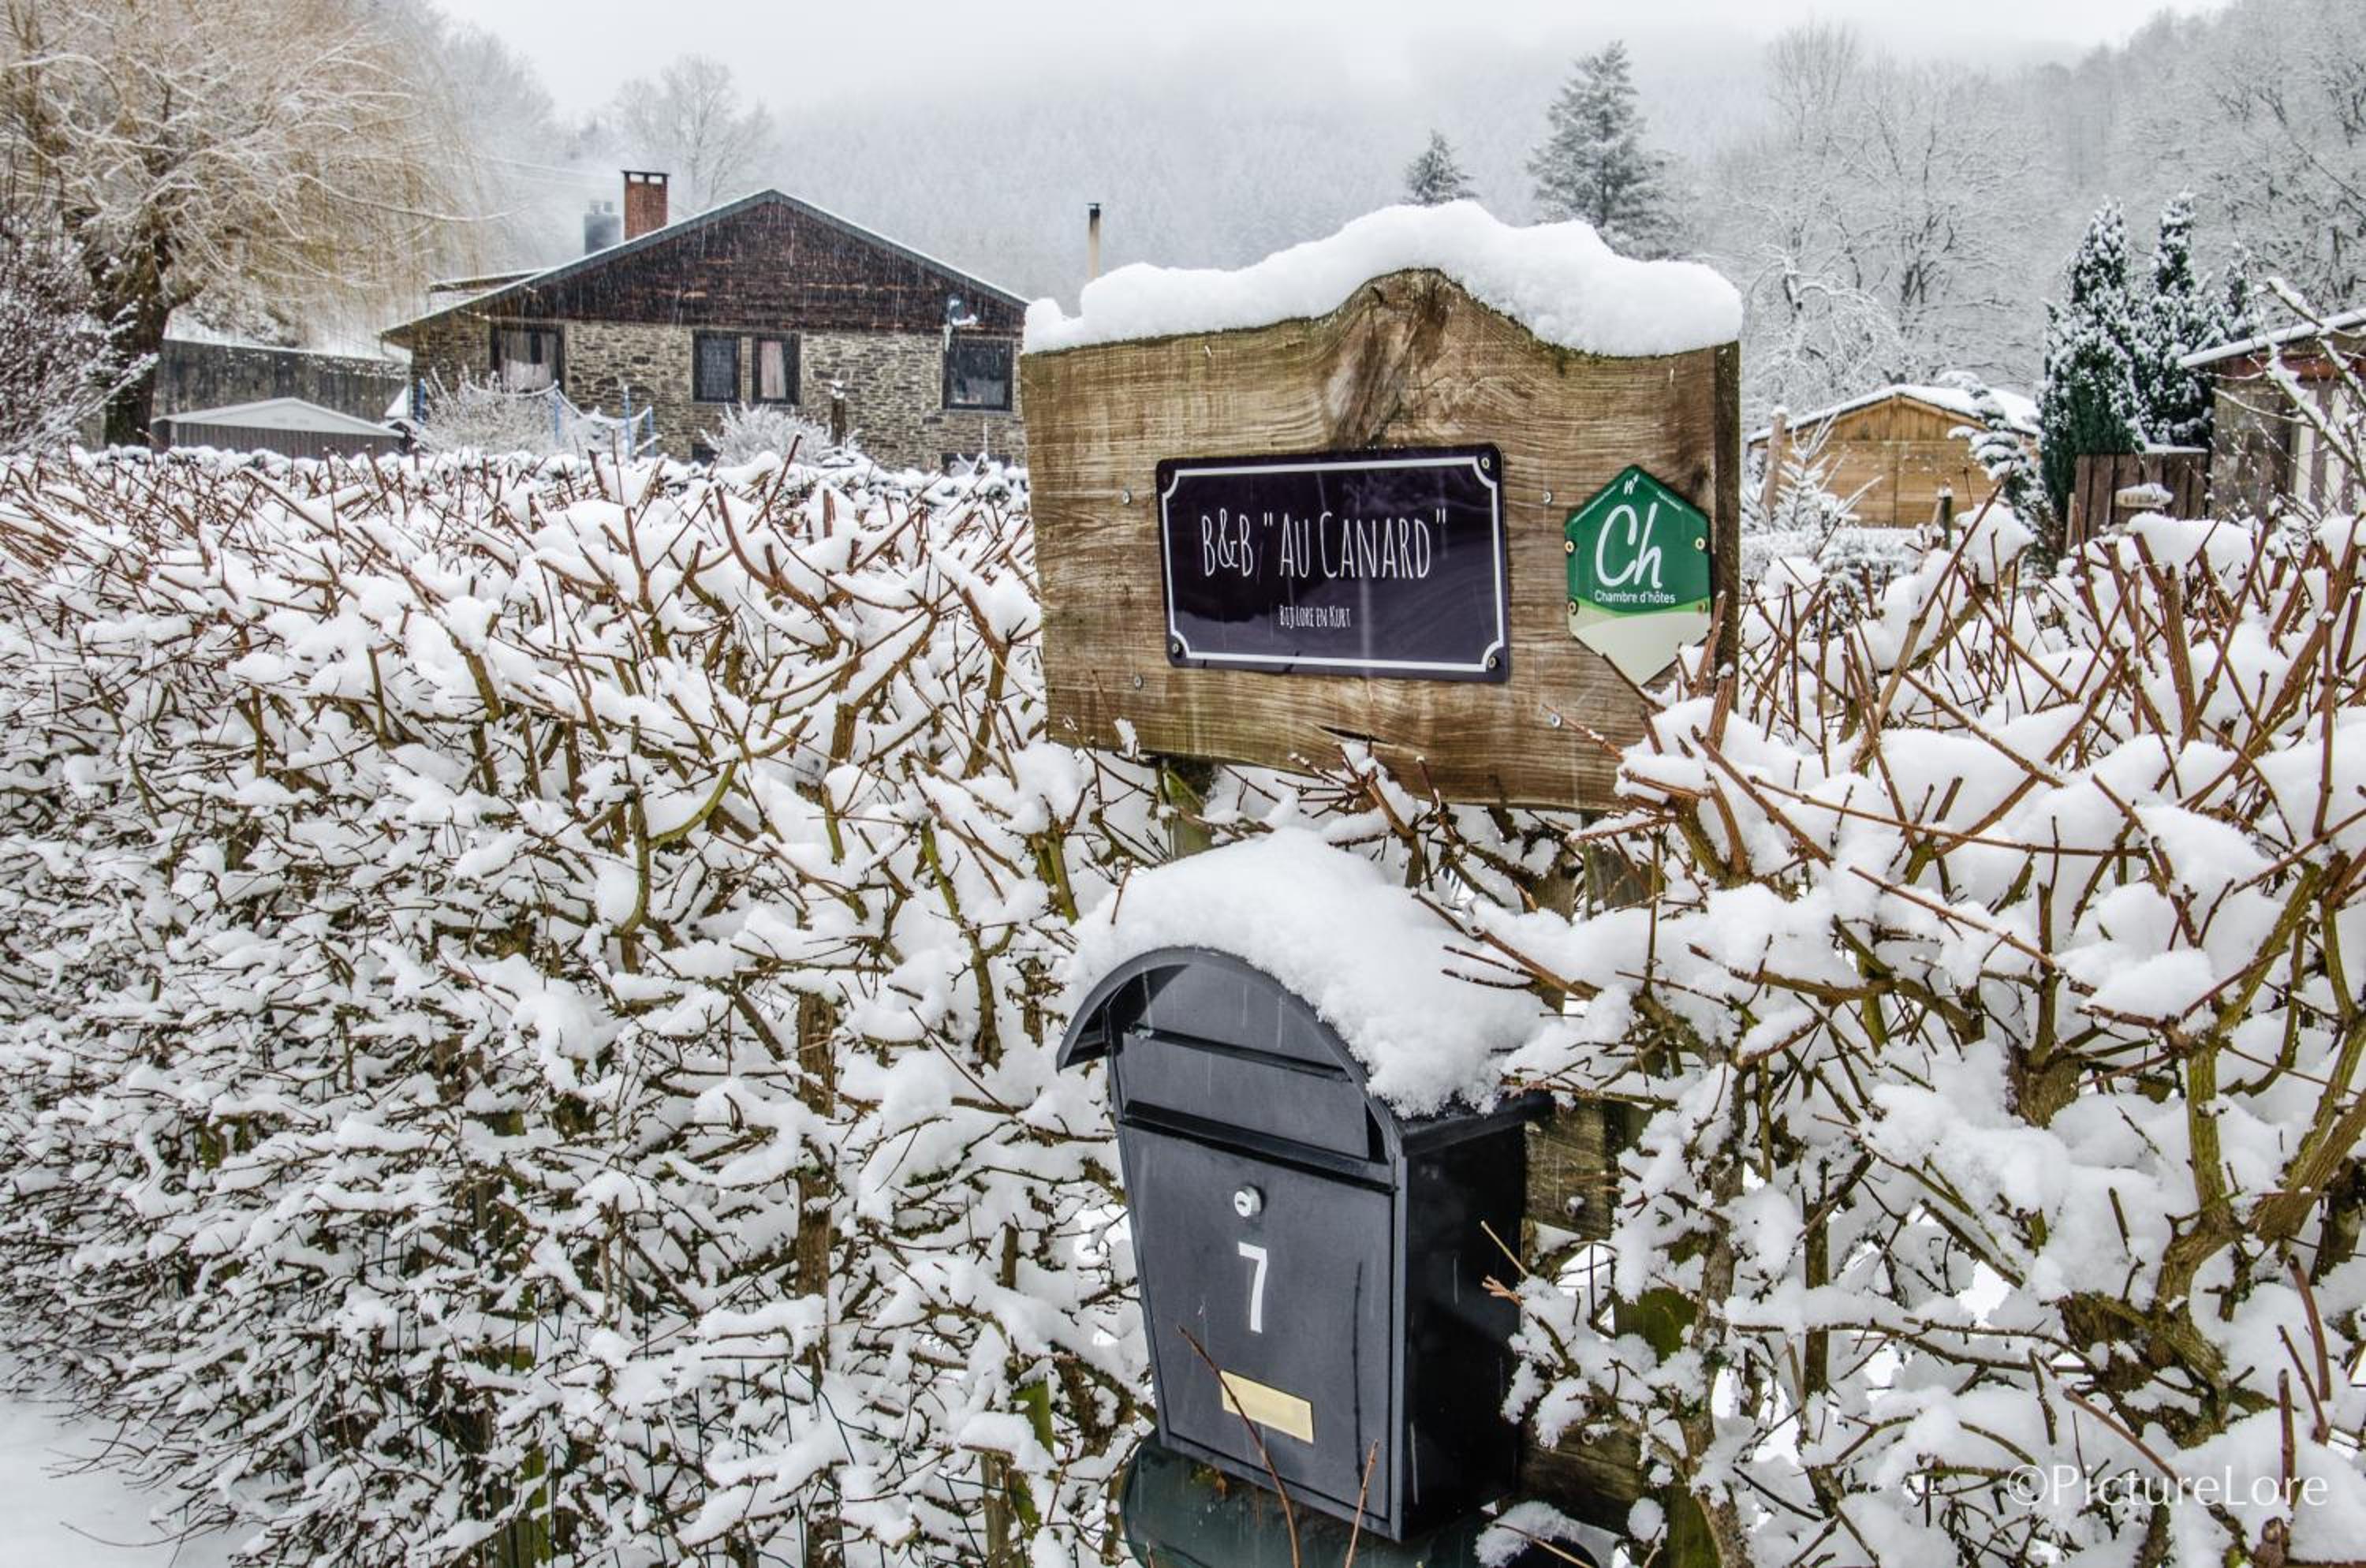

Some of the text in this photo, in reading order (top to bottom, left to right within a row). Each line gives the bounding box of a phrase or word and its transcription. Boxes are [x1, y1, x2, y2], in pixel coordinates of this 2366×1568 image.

[1201, 507, 1254, 578] B&B
[1595, 501, 1663, 589] Ch
[1594, 589, 1676, 604] Chambre d'hôtes
[1237, 1241, 1268, 1335] 7
